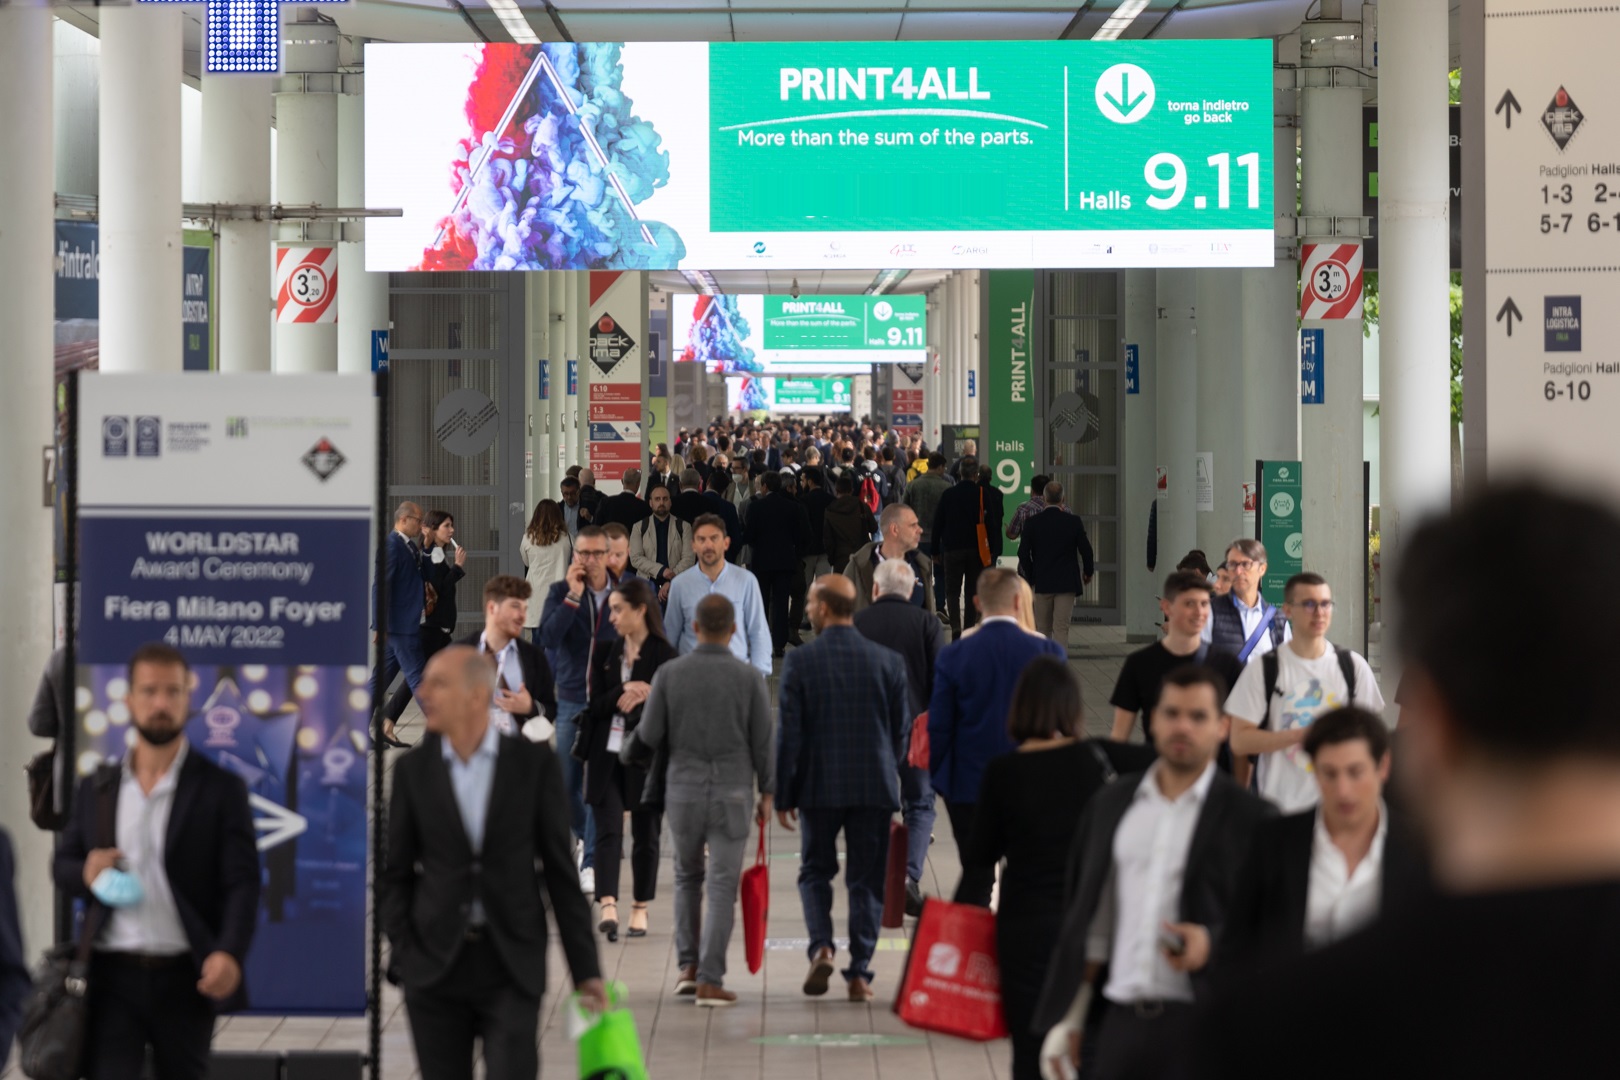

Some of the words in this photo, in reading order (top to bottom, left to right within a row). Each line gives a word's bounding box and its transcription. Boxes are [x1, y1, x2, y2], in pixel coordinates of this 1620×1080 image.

[780, 67, 990, 100] PRINT4ALL
[1168, 101, 1199, 112] torna
[1203, 99, 1250, 111] indietro
[1184, 114, 1200, 125] go
[1203, 112, 1233, 123] back
[738, 130, 785, 146] More
[790, 129, 832, 146] than
[838, 129, 869, 145] the
[874, 132, 914, 145] sum
[919, 128, 940, 145] of
[944, 129, 975, 145] the
[981, 129, 1034, 147] parts.
[1080, 190, 1131, 210] Halls
[1144, 152, 1259, 210] 9.11
[1539, 164, 1588, 178] Padiglioni
[1541, 184, 1573, 204] 1-3
[1594, 182, 1620, 203] 2-
[1540, 213, 1573, 234] 5-7
[297, 274, 309, 296] 3
[1319, 270, 1331, 292] 3
[782, 302, 845, 314] PRINT4ALL
[1552, 306, 1573, 317] INTRA
[1546, 318, 1580, 330] LOGISTICA
[887, 327, 923, 346] 9.11
[593, 346, 620, 358] ima
[1011, 302, 1026, 403] PRINT4ALL
[1544, 362, 1592, 376] Padiglioni
[1544, 380, 1591, 401] 6-10
[593, 406, 604, 414] 1.3
[996, 440, 1024, 452] Halls
[593, 463, 604, 471] 5.7
[996, 458, 1034, 494] 9.
[145, 532, 299, 555] WORLDSTAR
[131, 557, 200, 580] Award
[203, 557, 315, 586] Ceremony
[104, 595, 171, 621] Fiera
[176, 596, 264, 621] Milano
[269, 596, 346, 627] Foyer
[163, 625, 179, 648] 4
[181, 625, 231, 648] MAY
[230, 626, 285, 648] 2022
